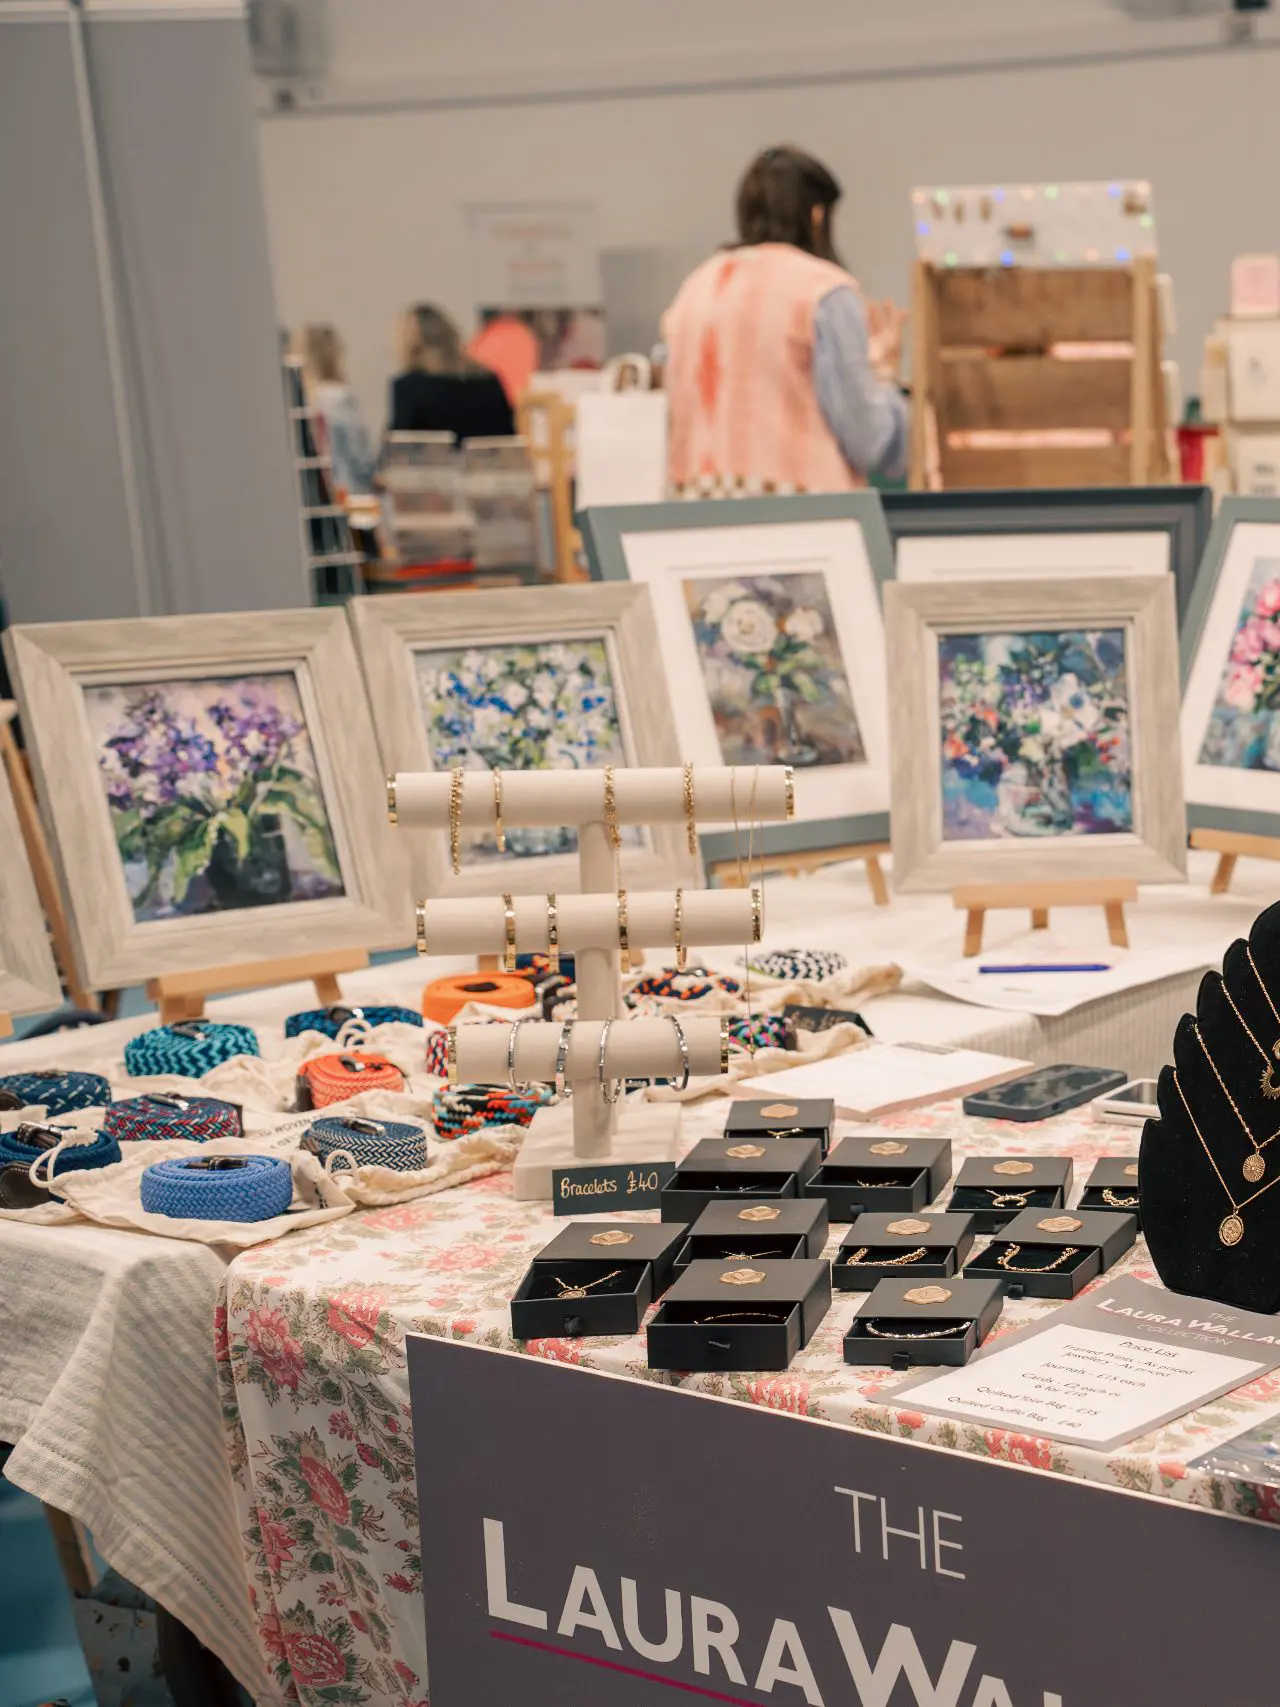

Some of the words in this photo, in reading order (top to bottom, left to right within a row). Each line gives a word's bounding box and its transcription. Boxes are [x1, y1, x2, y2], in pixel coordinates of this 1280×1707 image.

[560, 1177, 617, 1199] Bracelets
[626, 1170, 659, 1193] £40
[1096, 1298, 1181, 1328] LAURA
[1206, 1312, 1240, 1324] THE
[1136, 1324, 1234, 1347] COLLECTION
[1063, 1344, 1101, 1356] Framed
[1104, 1351, 1134, 1363] Prints
[1157, 1364, 1196, 1376] priced
[1118, 1341, 1152, 1352] Price
[1154, 1348, 1180, 1358] List
[1021, 1372, 1055, 1384] Cards
[1041, 1361, 1087, 1376] Journals
[1120, 1378, 1147, 1388] each
[1061, 1351, 1109, 1366] Jewellery
[1119, 1362, 1132, 1370] As
[1133, 1367, 1172, 1378] priced
[947, 1396, 990, 1409] Quilted
[1025, 1411, 1049, 1422] Bag
[976, 1386, 1020, 1400] Quilted
[1044, 1400, 1067, 1410] Bag
[834, 1485, 966, 1580] THE
[482, 1516, 826, 1707] LAURA
